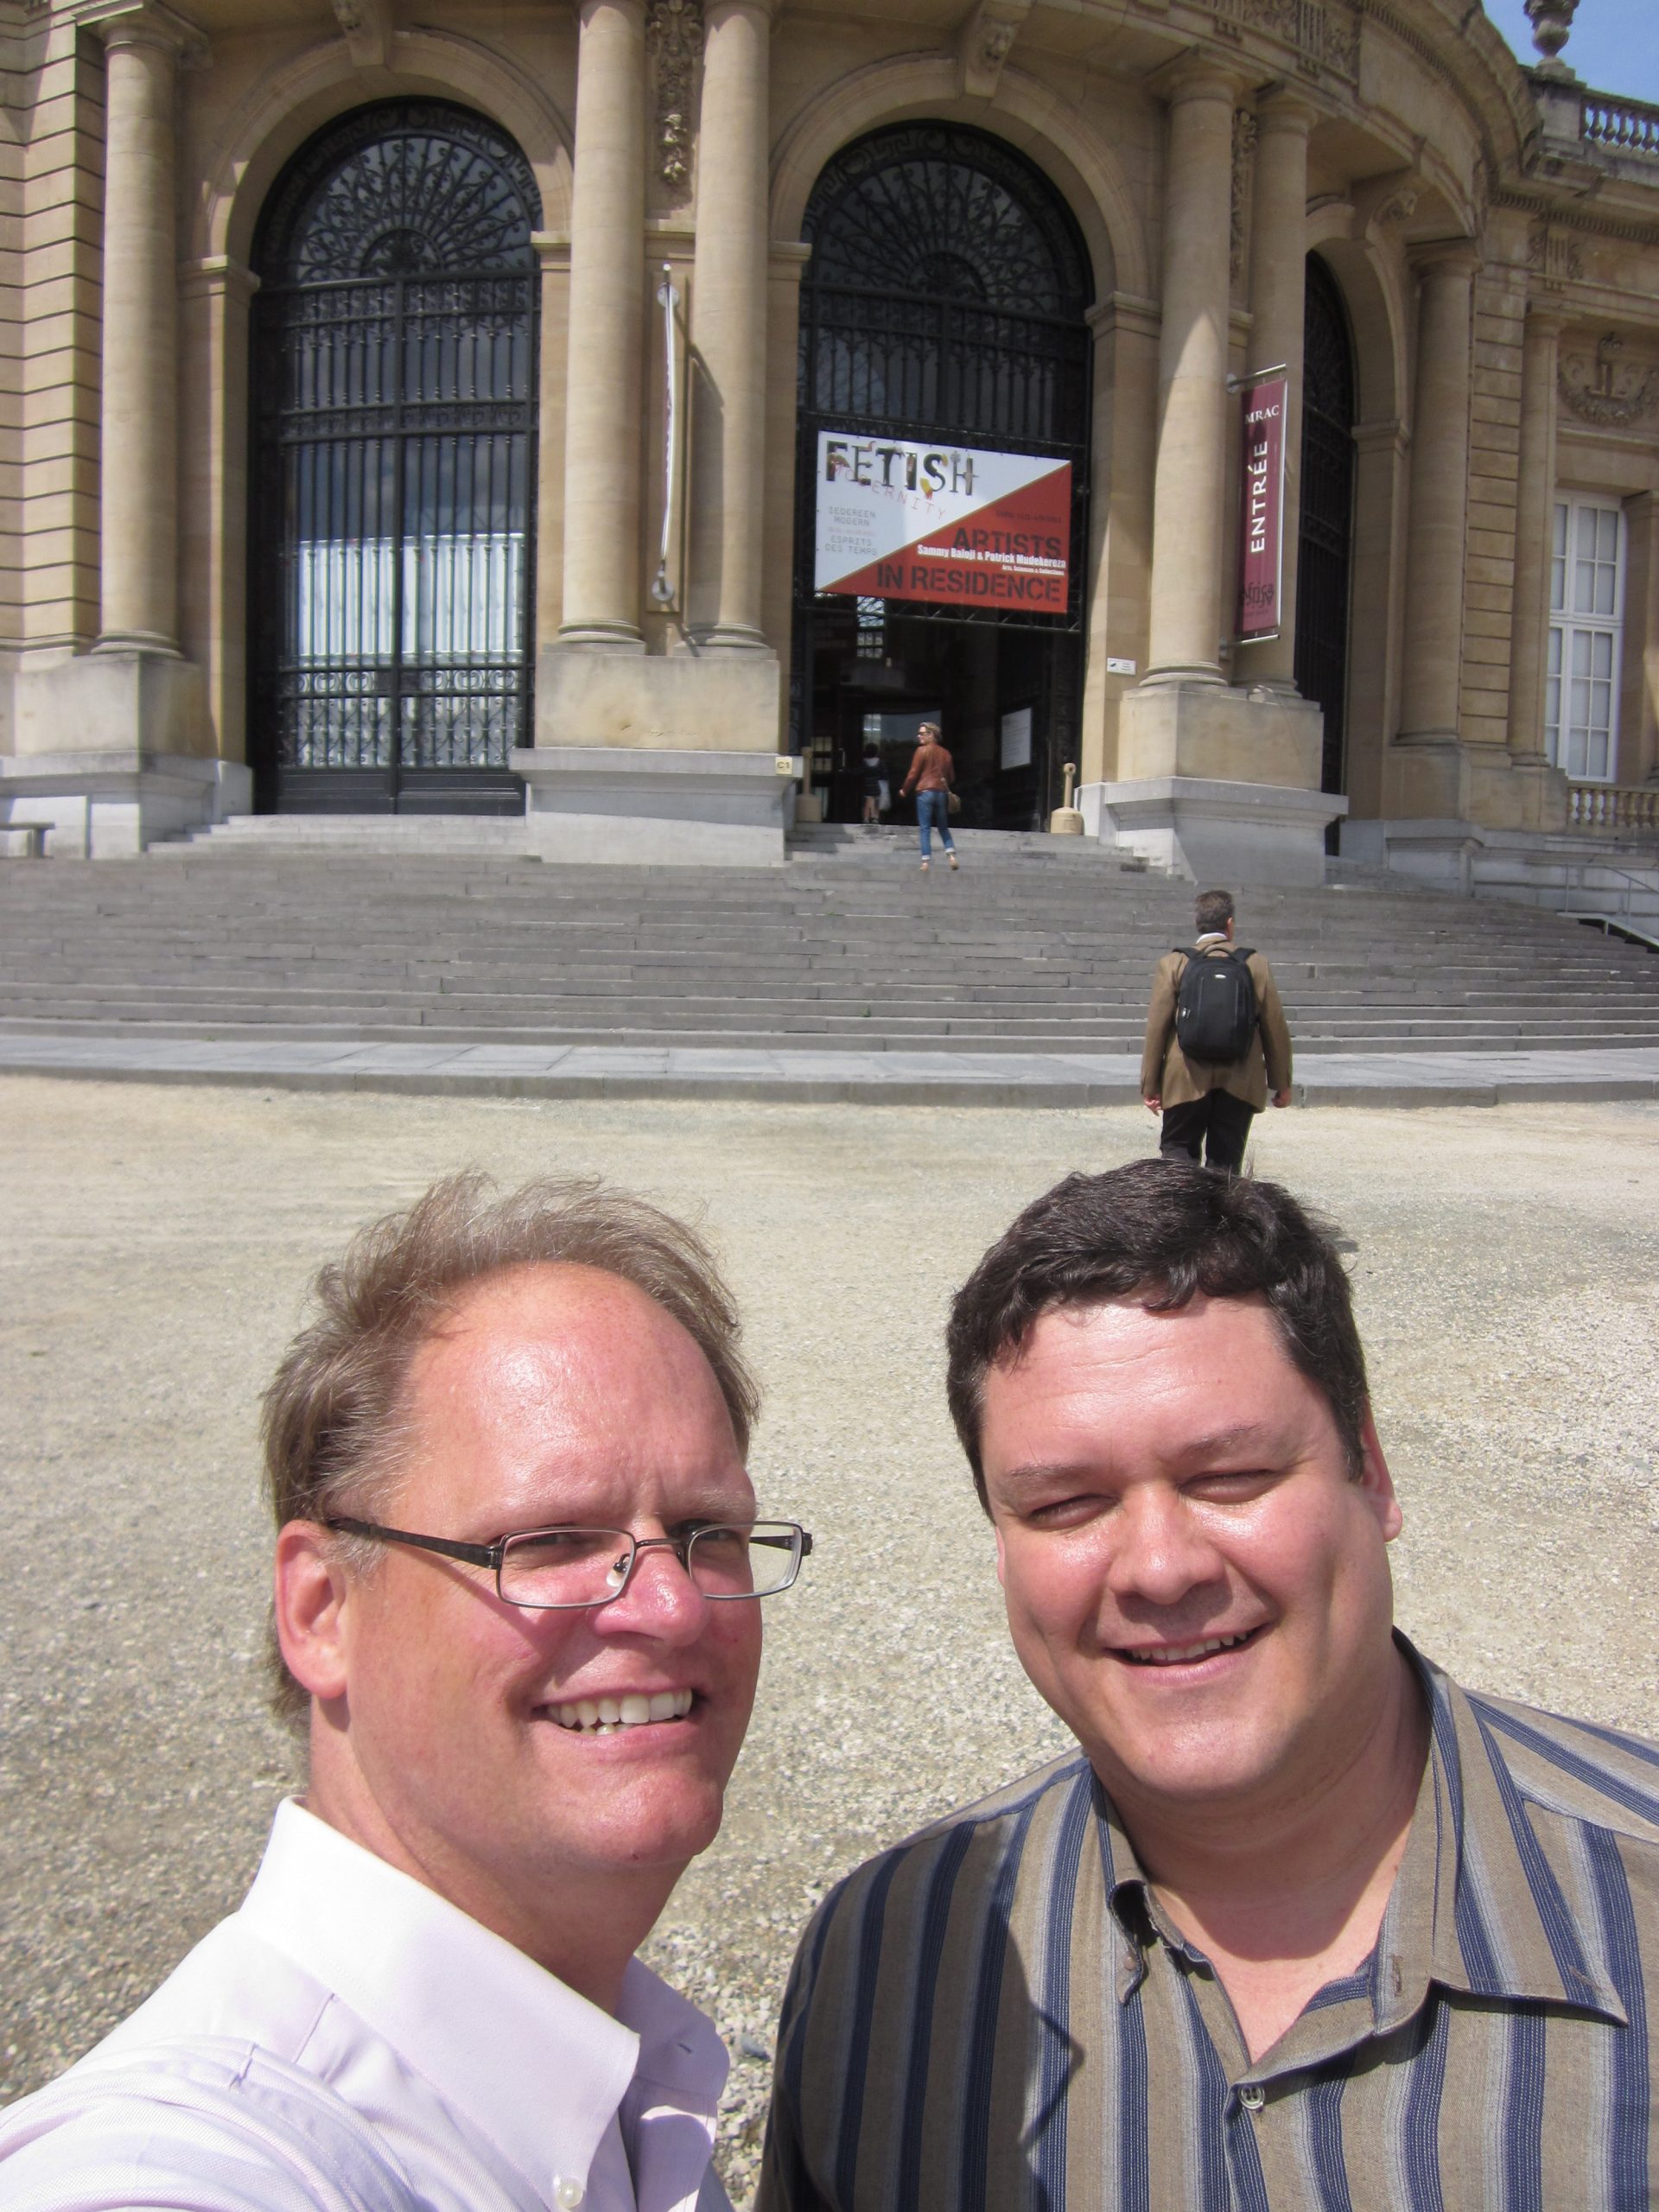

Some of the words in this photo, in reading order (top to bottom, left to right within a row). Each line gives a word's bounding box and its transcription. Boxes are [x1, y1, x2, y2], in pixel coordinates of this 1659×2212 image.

[1245, 405, 1280, 424] MRAC
[826, 441, 979, 496] FETISH
[1247, 441, 1268, 553] ENTRÉE
[834, 515, 870, 526] MODERN
[824, 543, 842, 553] DES
[849, 545, 878, 556] TEMPS
[830, 535, 872, 547] ESPRITS
[953, 527, 1061, 559] ARTISTS
[918, 544, 949, 558] Sammy
[951, 547, 975, 561] Baloji
[977, 552, 982, 561] &
[985, 550, 1015, 563] Patrick
[1016, 554, 1065, 568] Mudekereza
[877, 563, 903, 588] IN
[912, 565, 1060, 602] RESIDENCE
